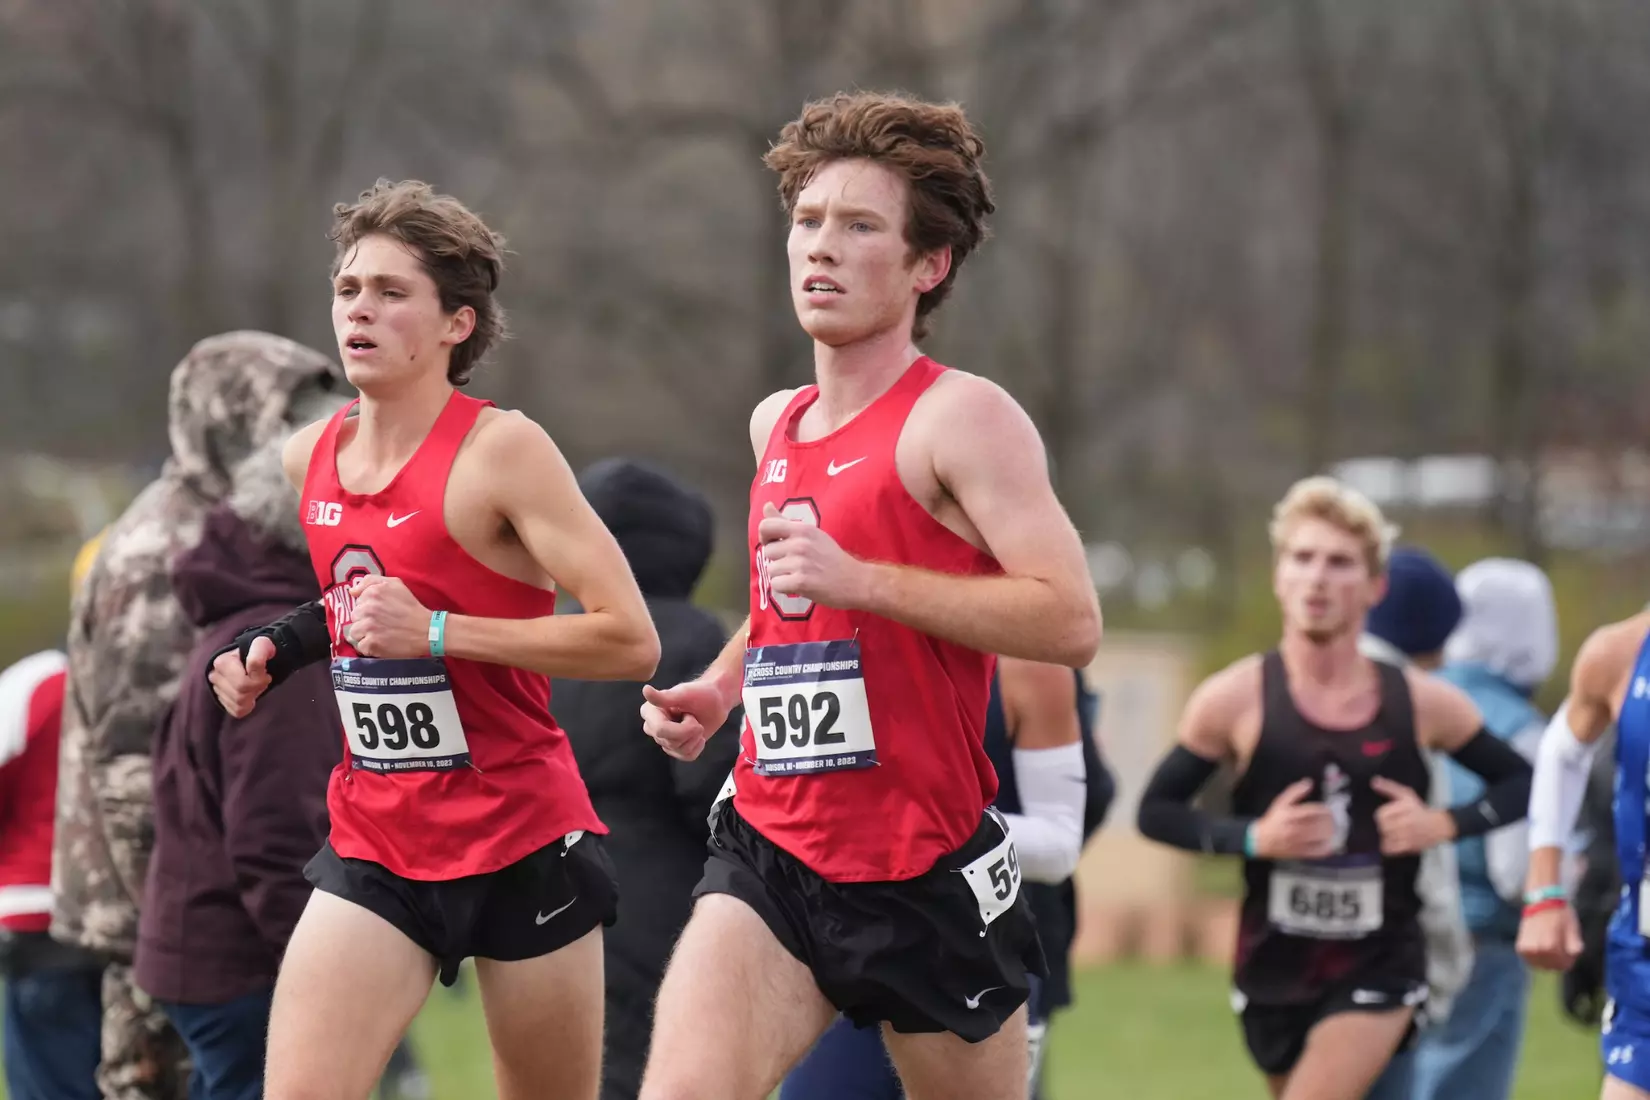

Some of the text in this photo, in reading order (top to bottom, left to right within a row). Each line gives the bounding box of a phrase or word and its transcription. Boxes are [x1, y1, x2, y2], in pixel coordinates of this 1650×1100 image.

[774, 664, 802, 676] COUNTRY
[802, 659, 859, 674] CHAMPIONSHIPS
[361, 676, 388, 687] COUNTRY
[389, 673, 446, 687] CHAMPIONSHIPS
[352, 702, 440, 751] 598
[759, 691, 846, 750] 592
[436, 758, 453, 768] 2023
[837, 756, 856, 766] 2023
[1290, 886, 1360, 920] 685
